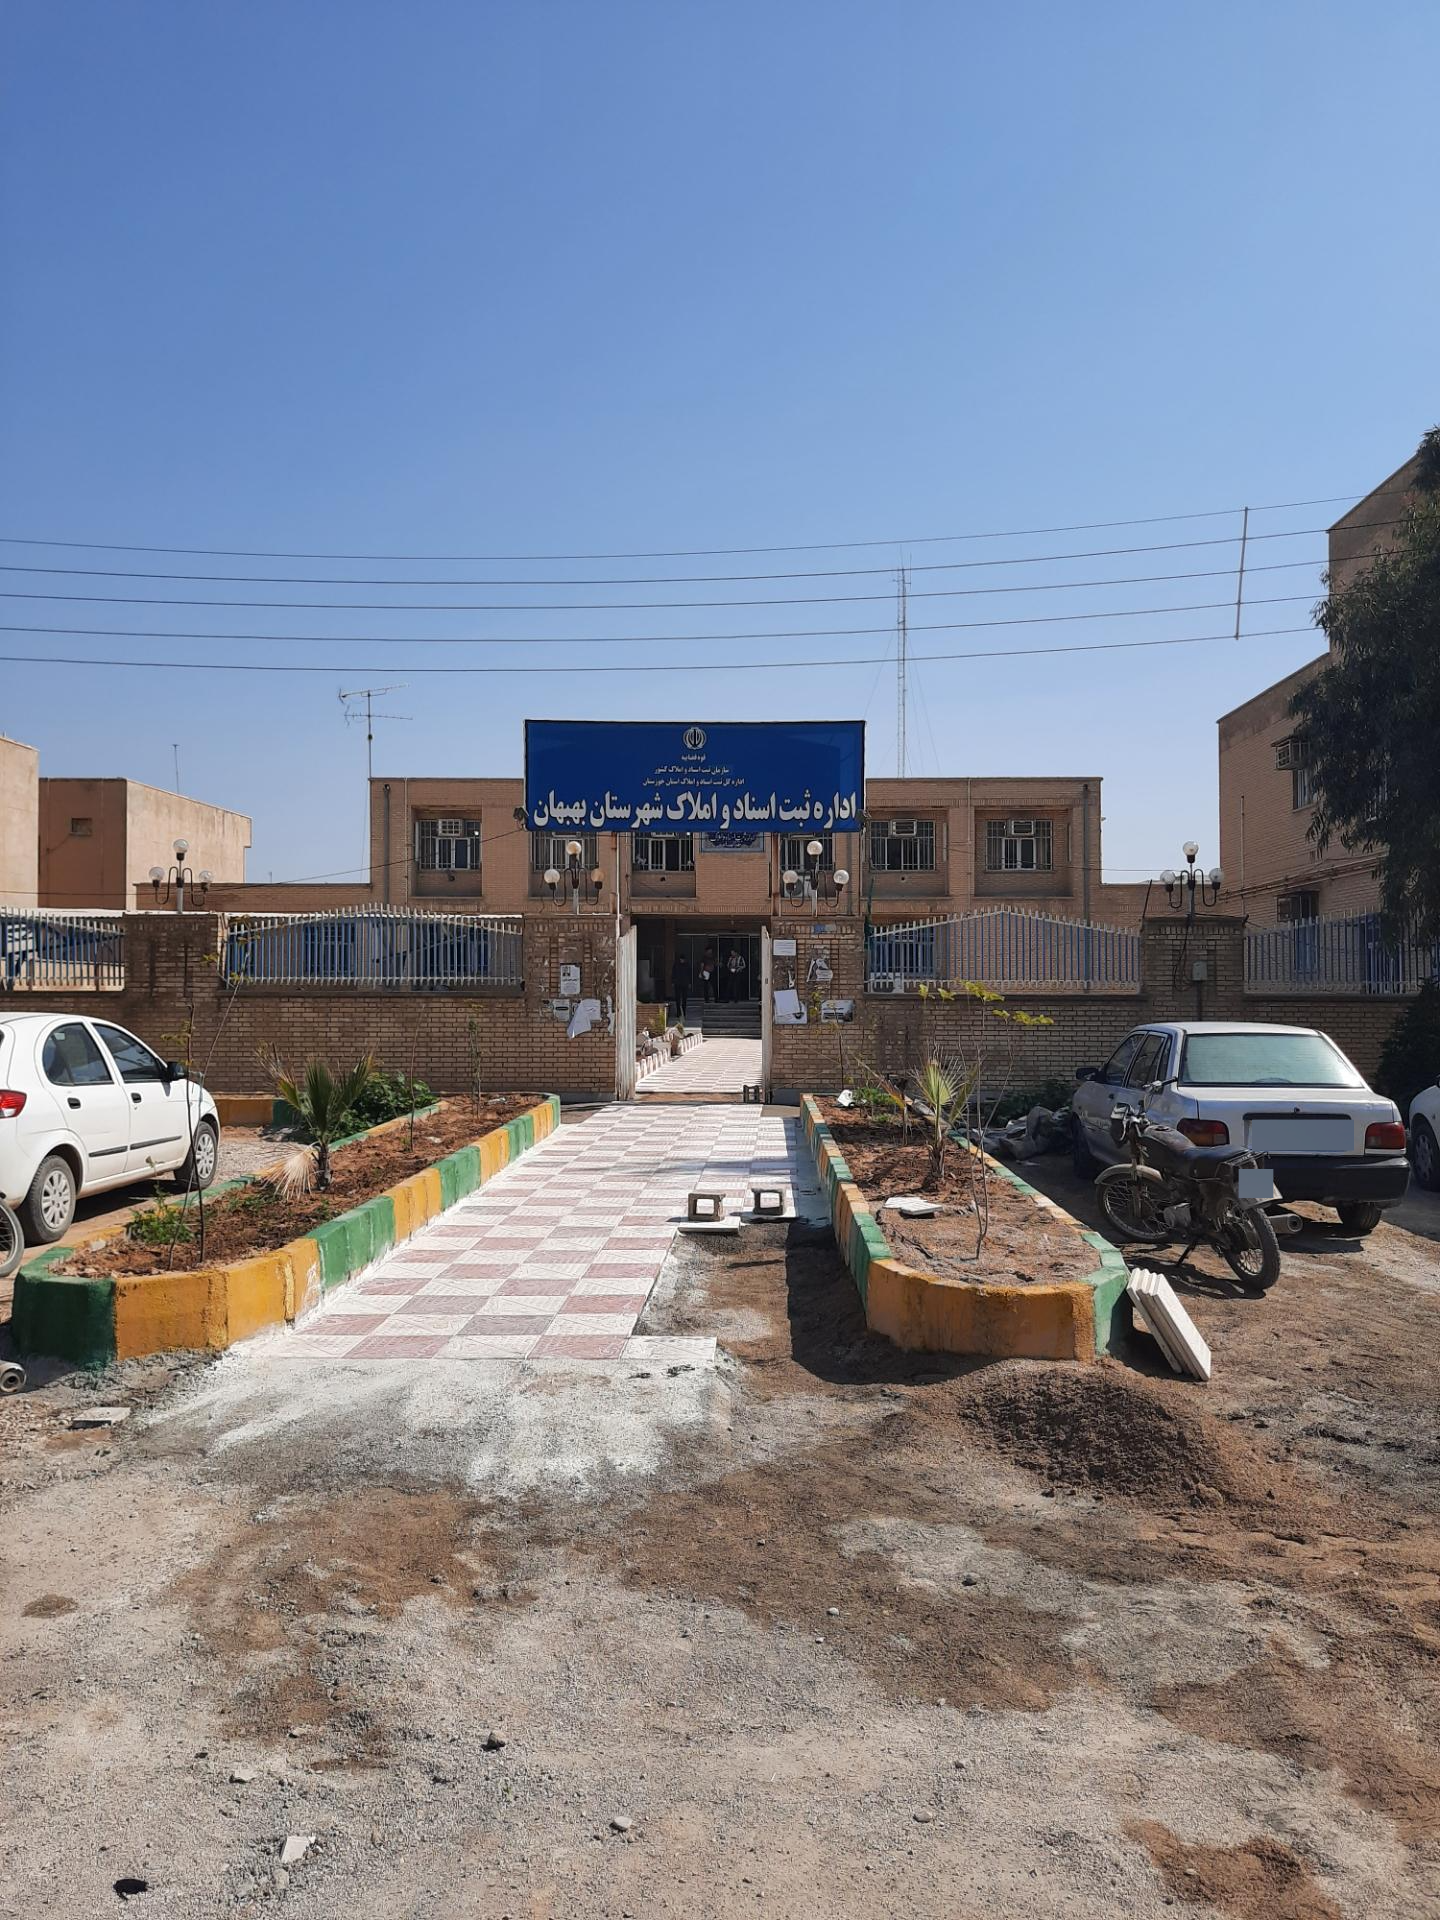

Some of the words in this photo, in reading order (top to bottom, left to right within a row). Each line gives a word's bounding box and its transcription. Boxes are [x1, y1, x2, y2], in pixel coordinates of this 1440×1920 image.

[654, 765, 668, 775] کشور
[668, 765, 684, 774] املاک
[711, 765, 729, 775] سازمان
[642, 777, 665, 787] خوزستان
[665, 778, 680, 787] استان
[680, 778, 696, 786] املاک
[713, 778, 723, 786] ثبت
[723, 778, 731, 787] کل
[732, 778, 745, 787] اداره
[533, 789, 587, 827] بهبهان
[590, 791, 663, 829] شهرستان
[666, 790, 717, 821] املاک
[733, 791, 776, 820] اسناد
[779, 789, 810, 827] ثبت
[813, 791, 856, 829] اداره
[719, 804, 731, 829] و
